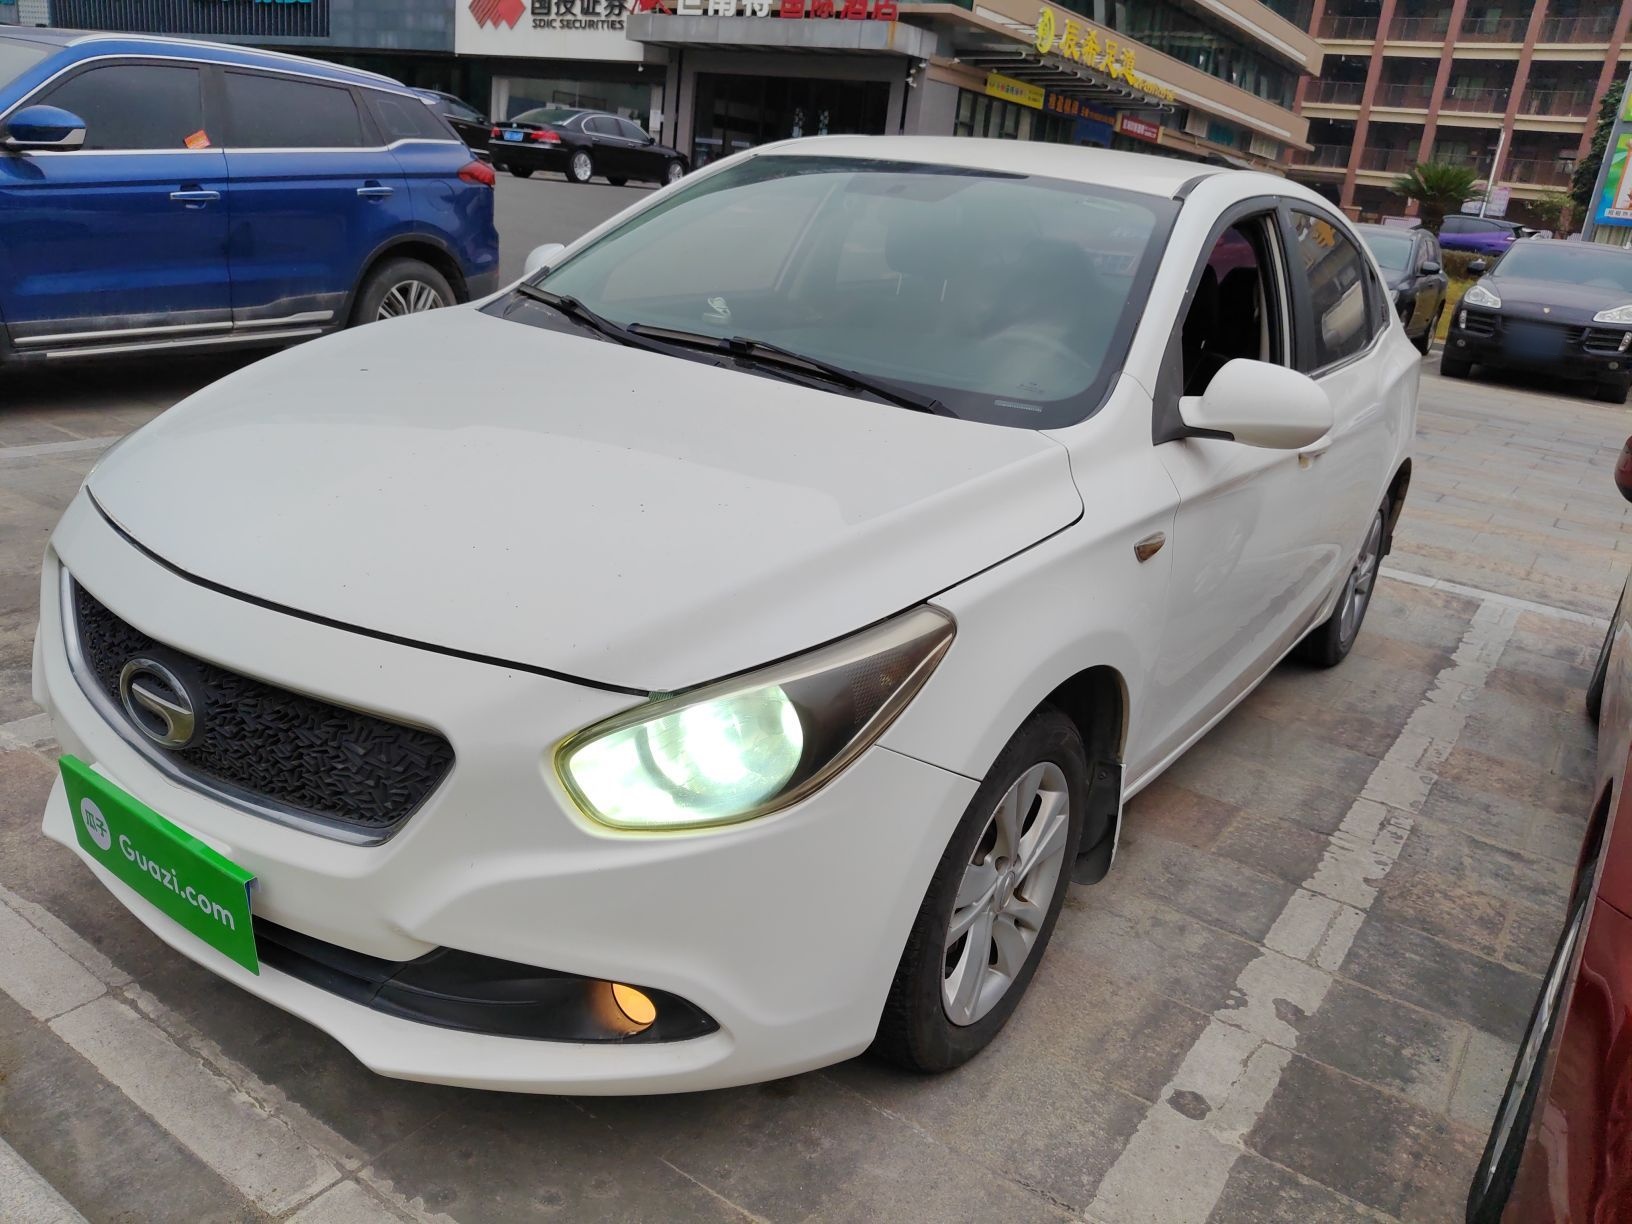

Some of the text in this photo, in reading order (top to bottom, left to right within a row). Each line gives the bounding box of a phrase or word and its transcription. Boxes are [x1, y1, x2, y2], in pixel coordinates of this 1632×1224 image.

[531, 0, 627, 17] 国投证券
[532, 18, 624, 31] SDIC SECURITIES
[118, 833, 236, 932] Guazi.com
